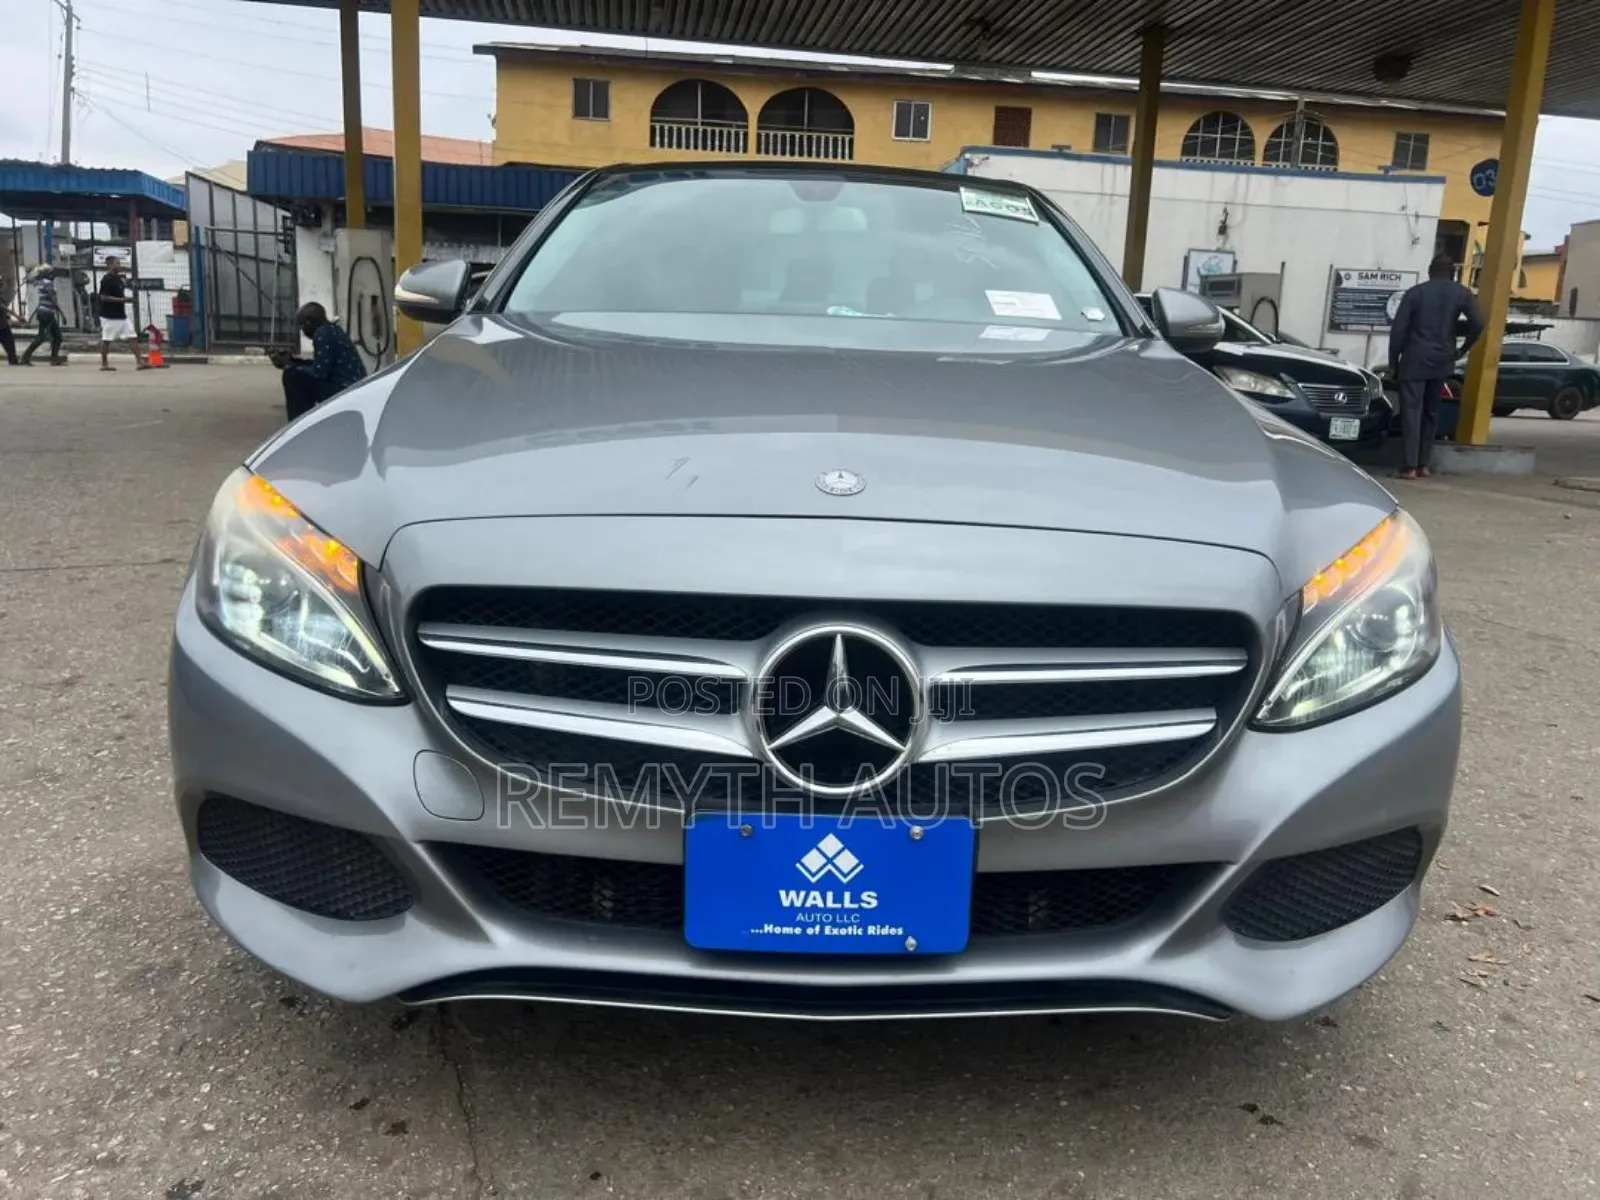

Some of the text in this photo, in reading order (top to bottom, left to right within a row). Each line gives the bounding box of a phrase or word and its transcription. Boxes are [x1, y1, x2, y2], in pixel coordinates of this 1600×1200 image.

[1358, 272, 1379, 280] SAM
[779, 890, 878, 908] WALLS
[796, 913, 860, 923] AUTO LLC
[806, 925, 820, 935] of
[825, 925, 863, 935] Exotic
[867, 925, 903, 936] Rides
